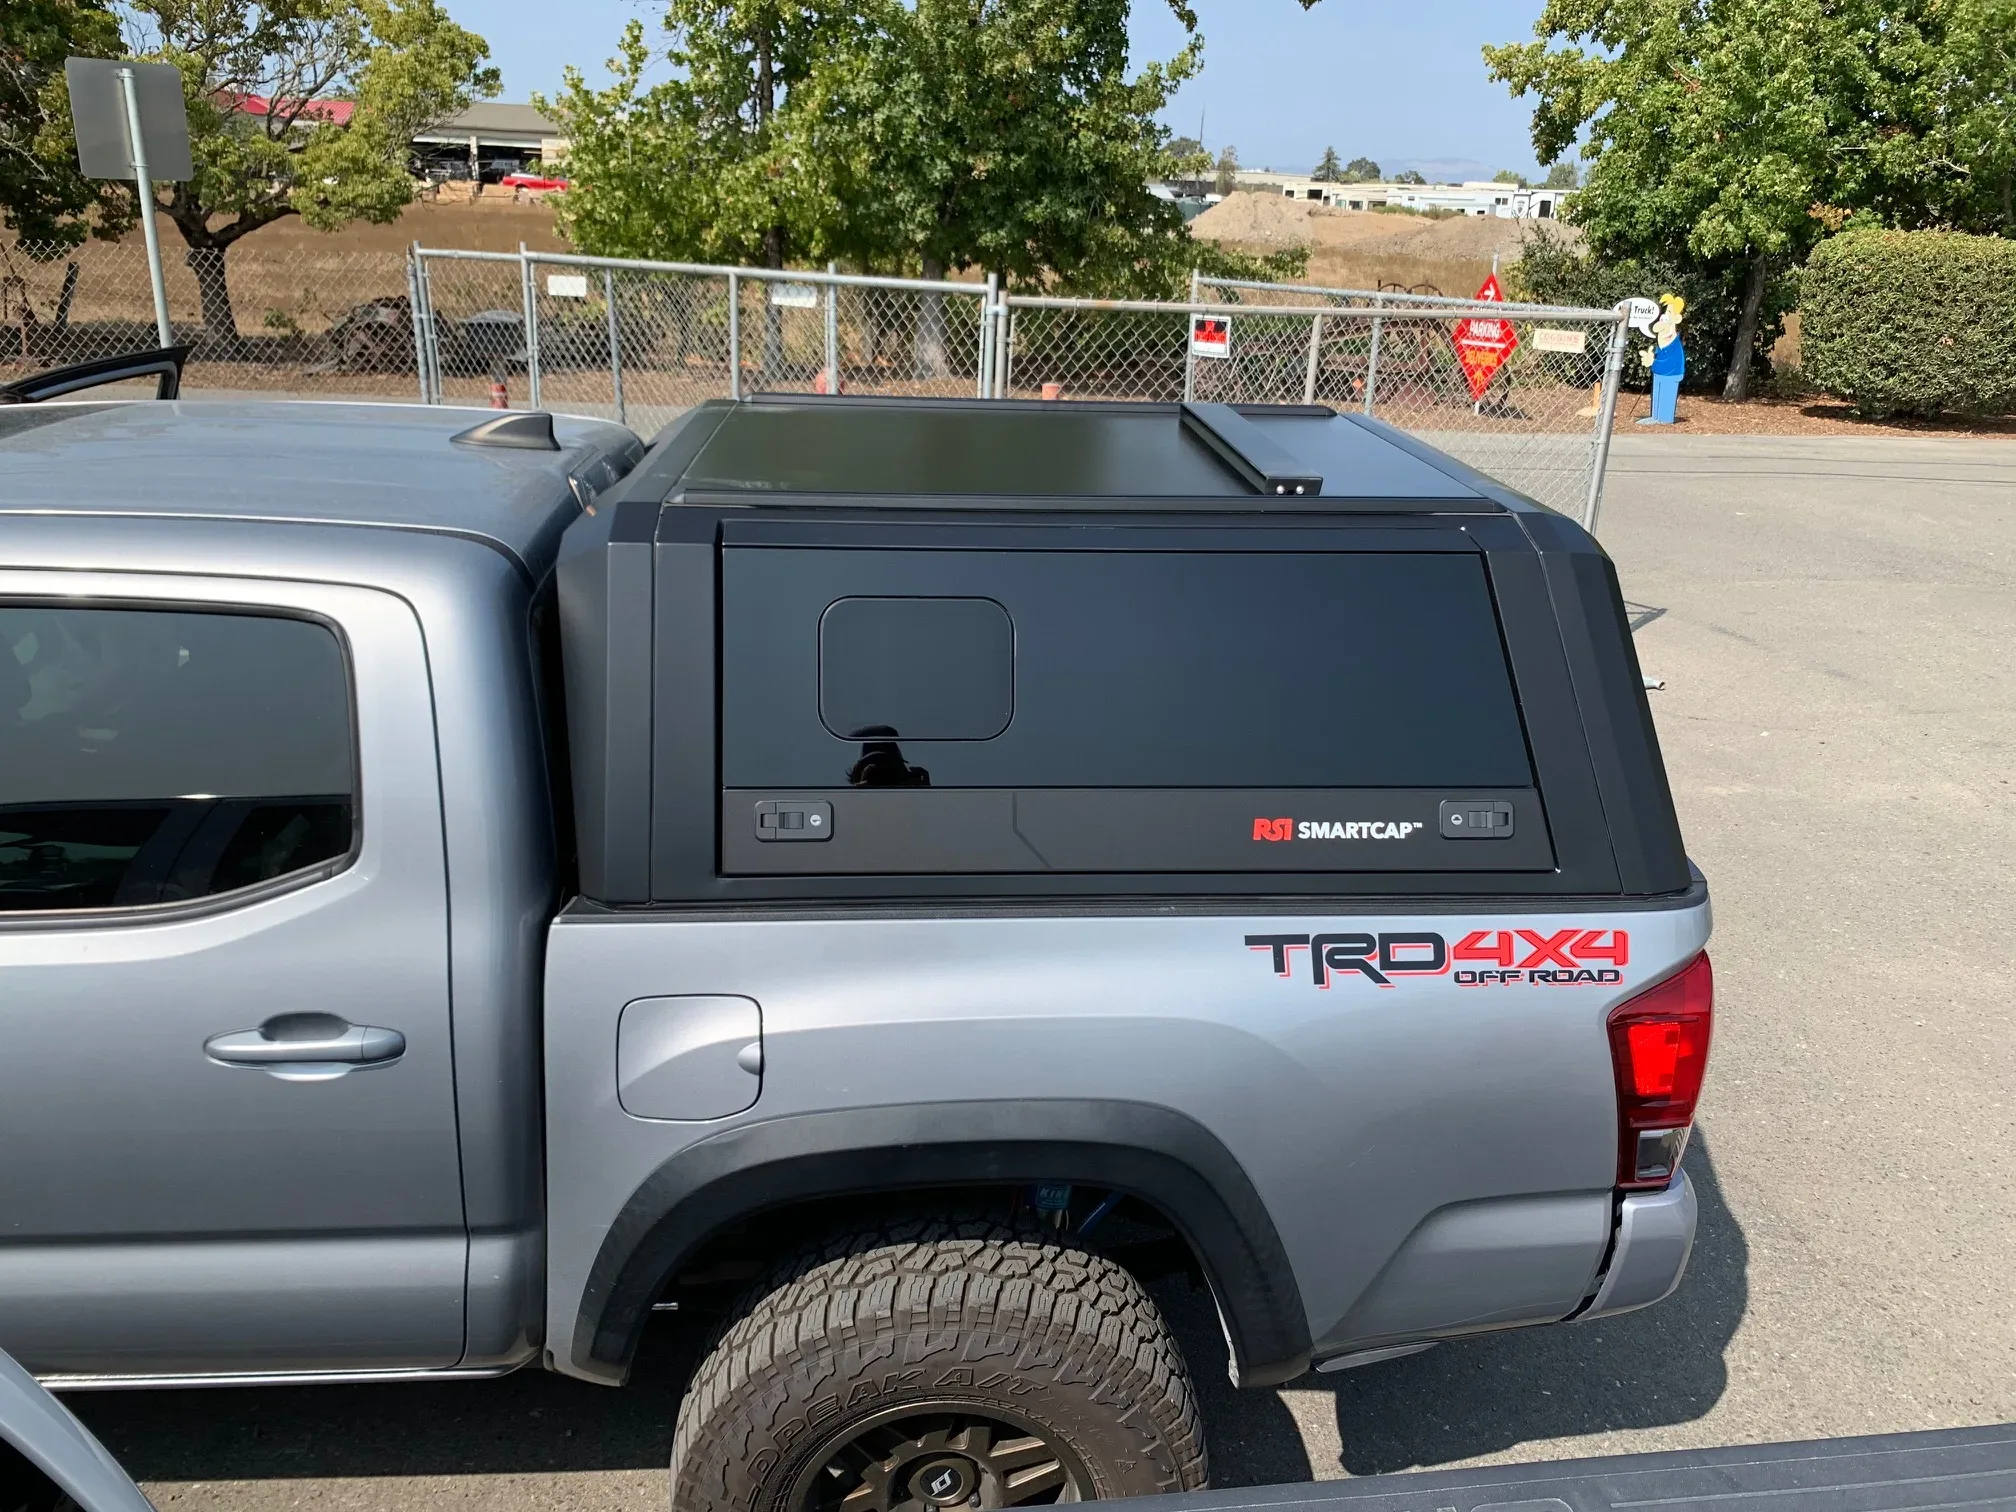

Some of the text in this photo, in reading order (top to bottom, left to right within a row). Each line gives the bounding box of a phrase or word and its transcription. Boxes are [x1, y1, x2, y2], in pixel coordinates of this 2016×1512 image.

[1634, 305, 1655, 315] Truck!
[1469, 319, 1501, 339] PARKING
[1244, 928, 1629, 990] TRD 4X4
[1453, 969, 1624, 987] OFF ROAD
